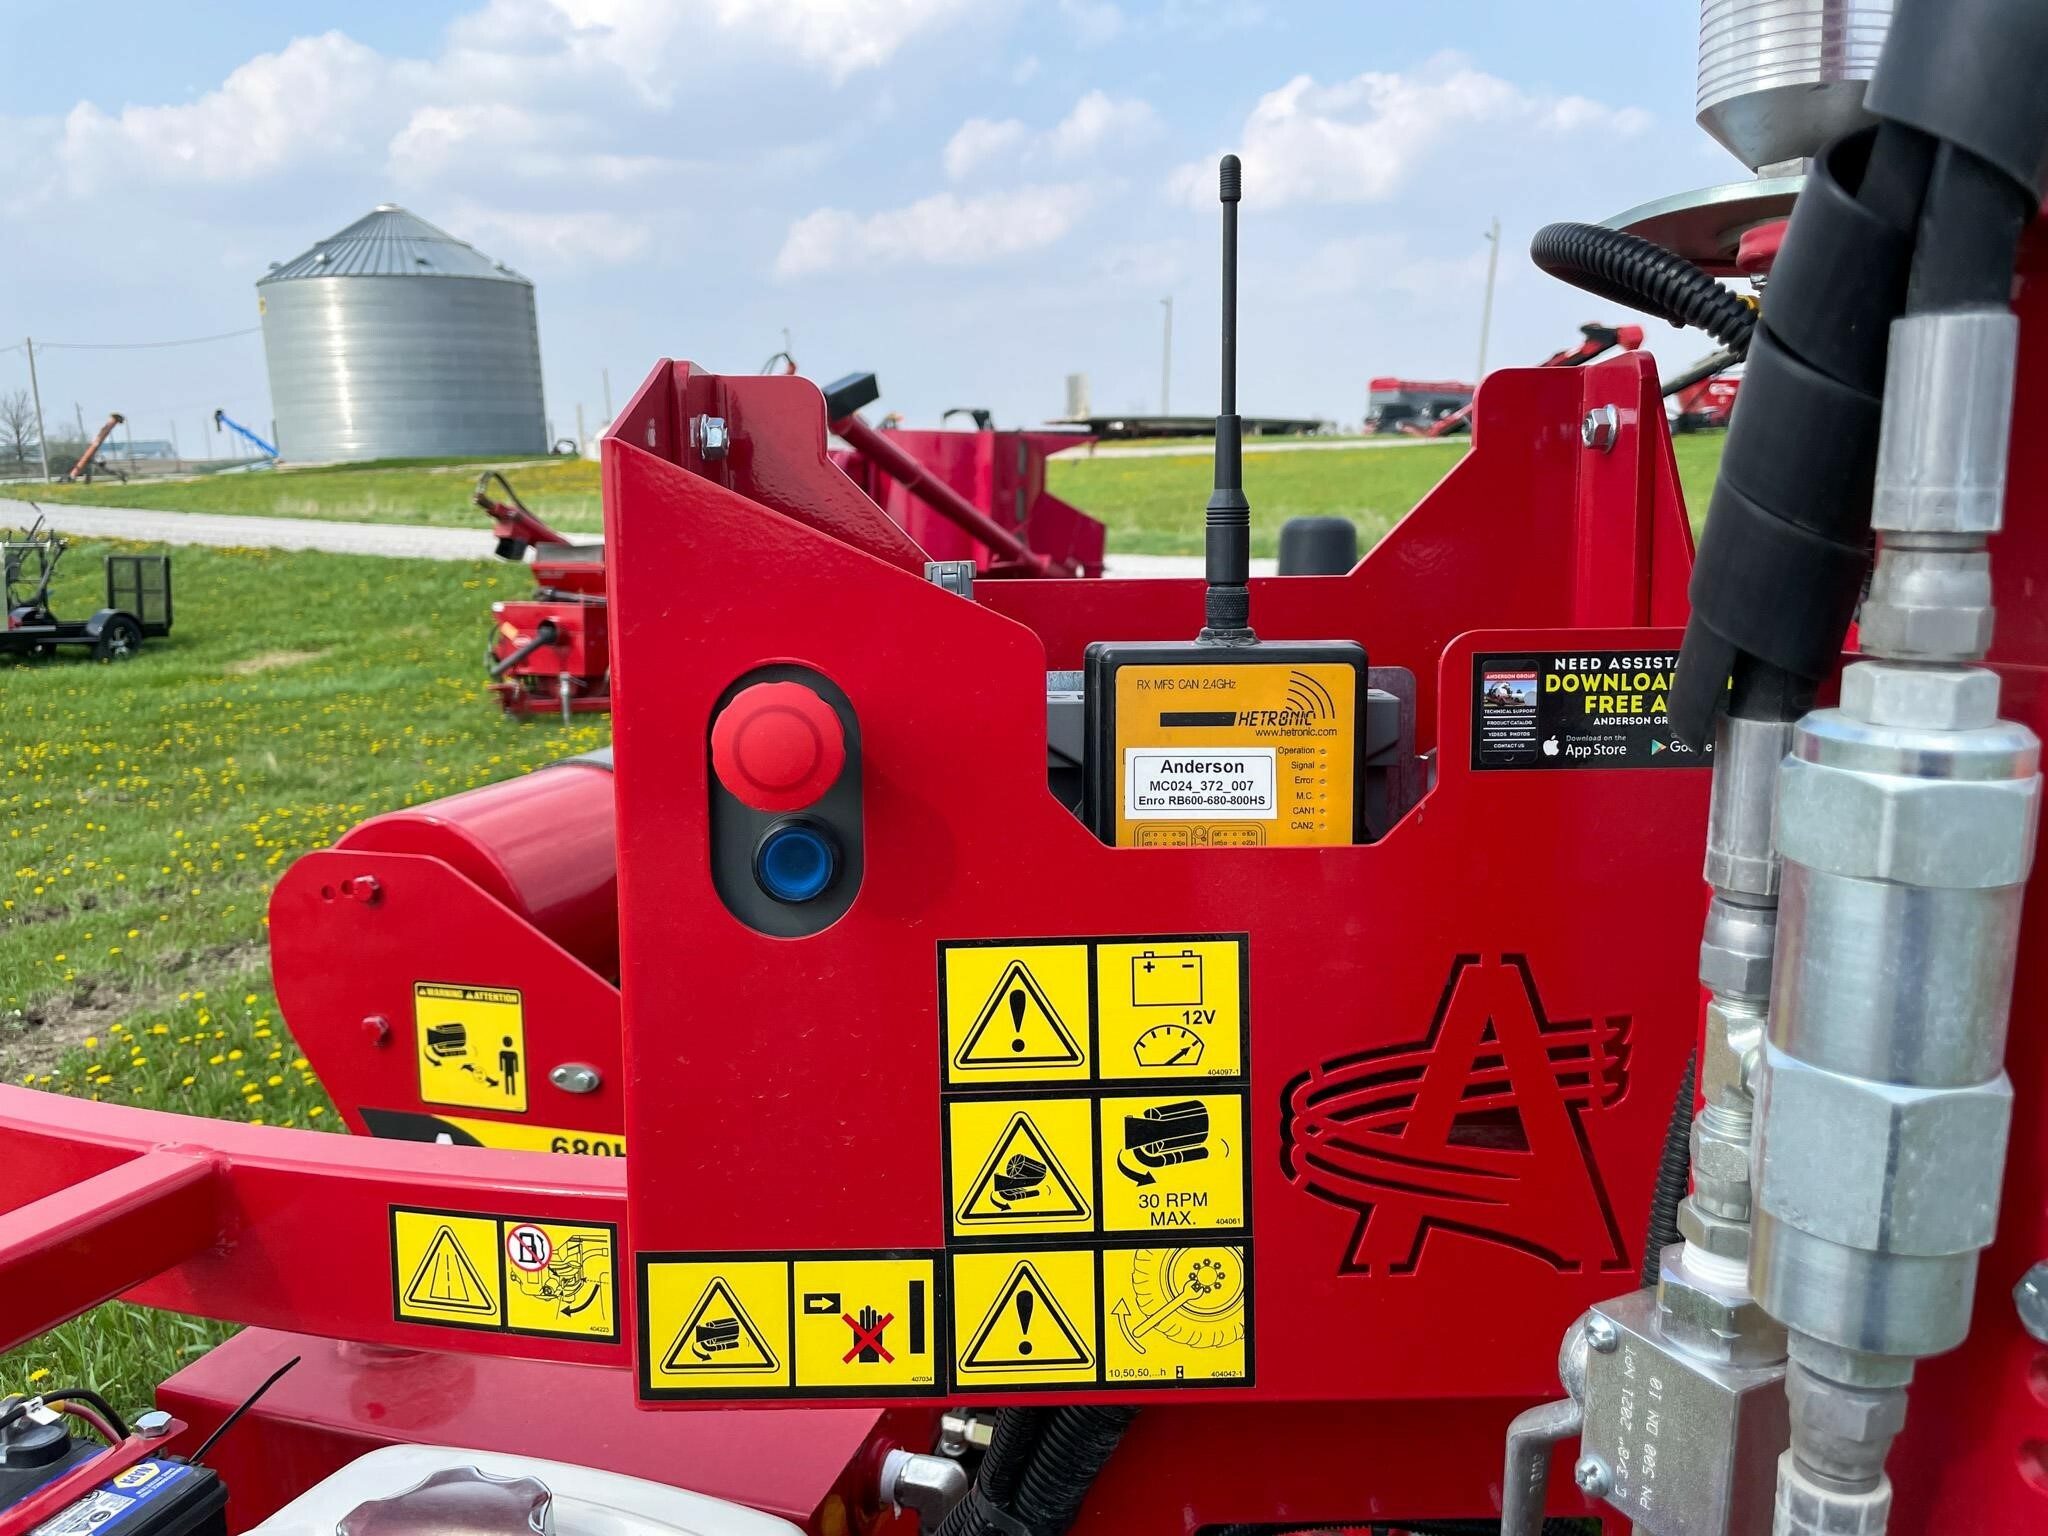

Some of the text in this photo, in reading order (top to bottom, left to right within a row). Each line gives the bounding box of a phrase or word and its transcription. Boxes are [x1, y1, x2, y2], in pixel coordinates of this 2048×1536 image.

[1554, 656, 1680, 670] NEED ASSIST
[1136, 678, 1236, 690] RX MFS CAN 2.4GHz
[1584, 694, 1643, 714] FREE
[1238, 710, 1315, 726] HETRONIC
[1593, 716, 1650, 726] ANDERSON
[1255, 728, 1337, 736] www.hetronic.com
[1566, 734, 1602, 742] Download
[1278, 746, 1315, 755] Operation
[1565, 744, 1627, 758] App Store
[1160, 759, 1244, 774] Anderson
[1291, 761, 1315, 770] Signal
[1294, 776, 1314, 784] Error
[1149, 780, 1254, 794] MC024_372_007
[1138, 795, 1266, 806] Enro RB600-680-800HS
[1292, 806, 1315, 815] CAN1
[1290, 822, 1314, 830] CAN2
[474, 990, 518, 1003] ATTENTION
[1182, 1009, 1216, 1025] 12V
[1208, 1068, 1240, 1076] 404097-1
[1138, 1192, 1208, 1208] 30 RPM
[1150, 1210, 1196, 1226] MAX.
[1210, 1370, 1243, 1378] 404042-1
[1620, 1388, 1634, 1432] 2021
[1640, 1376, 1662, 1511] PN 500 DN 10
[119, 1466, 153, 1484] NAPA
